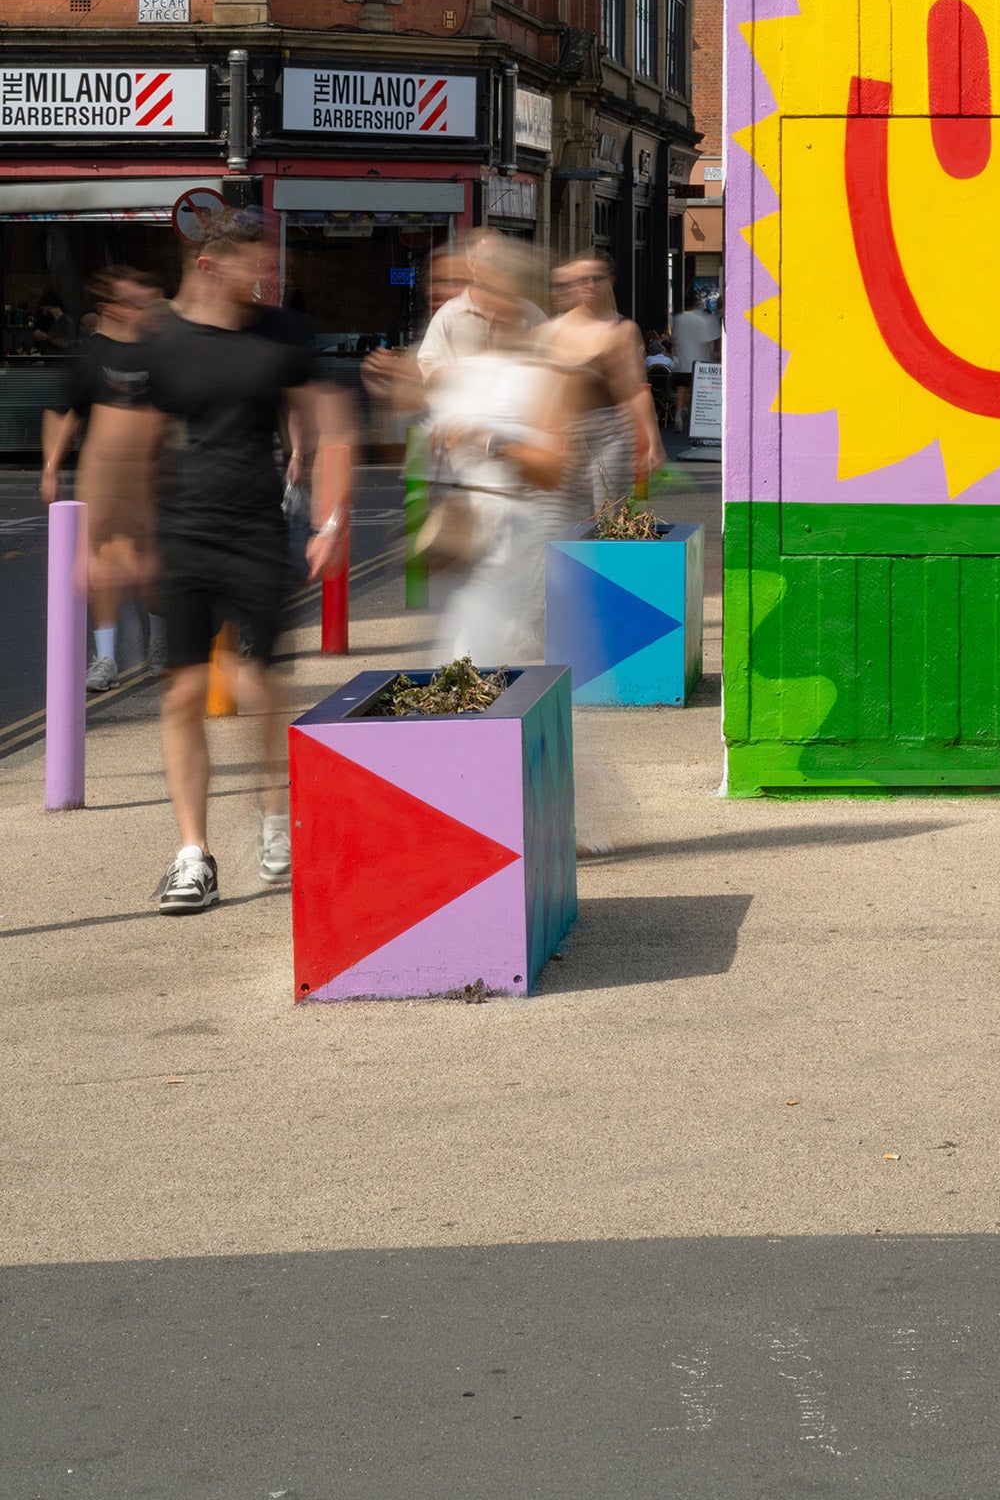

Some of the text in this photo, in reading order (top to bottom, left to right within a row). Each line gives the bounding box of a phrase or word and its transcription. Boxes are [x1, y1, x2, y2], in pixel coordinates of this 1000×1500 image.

[139, 9, 188, 20] STREET
[3, 72, 23, 104] THE
[25, 73, 133, 103] MILANO
[314, 73, 331, 104] THE
[332, 74, 416, 108] MILANO
[2, 106, 131, 126] BARBERSHOP
[313, 108, 416, 130] BARBERSHOP
